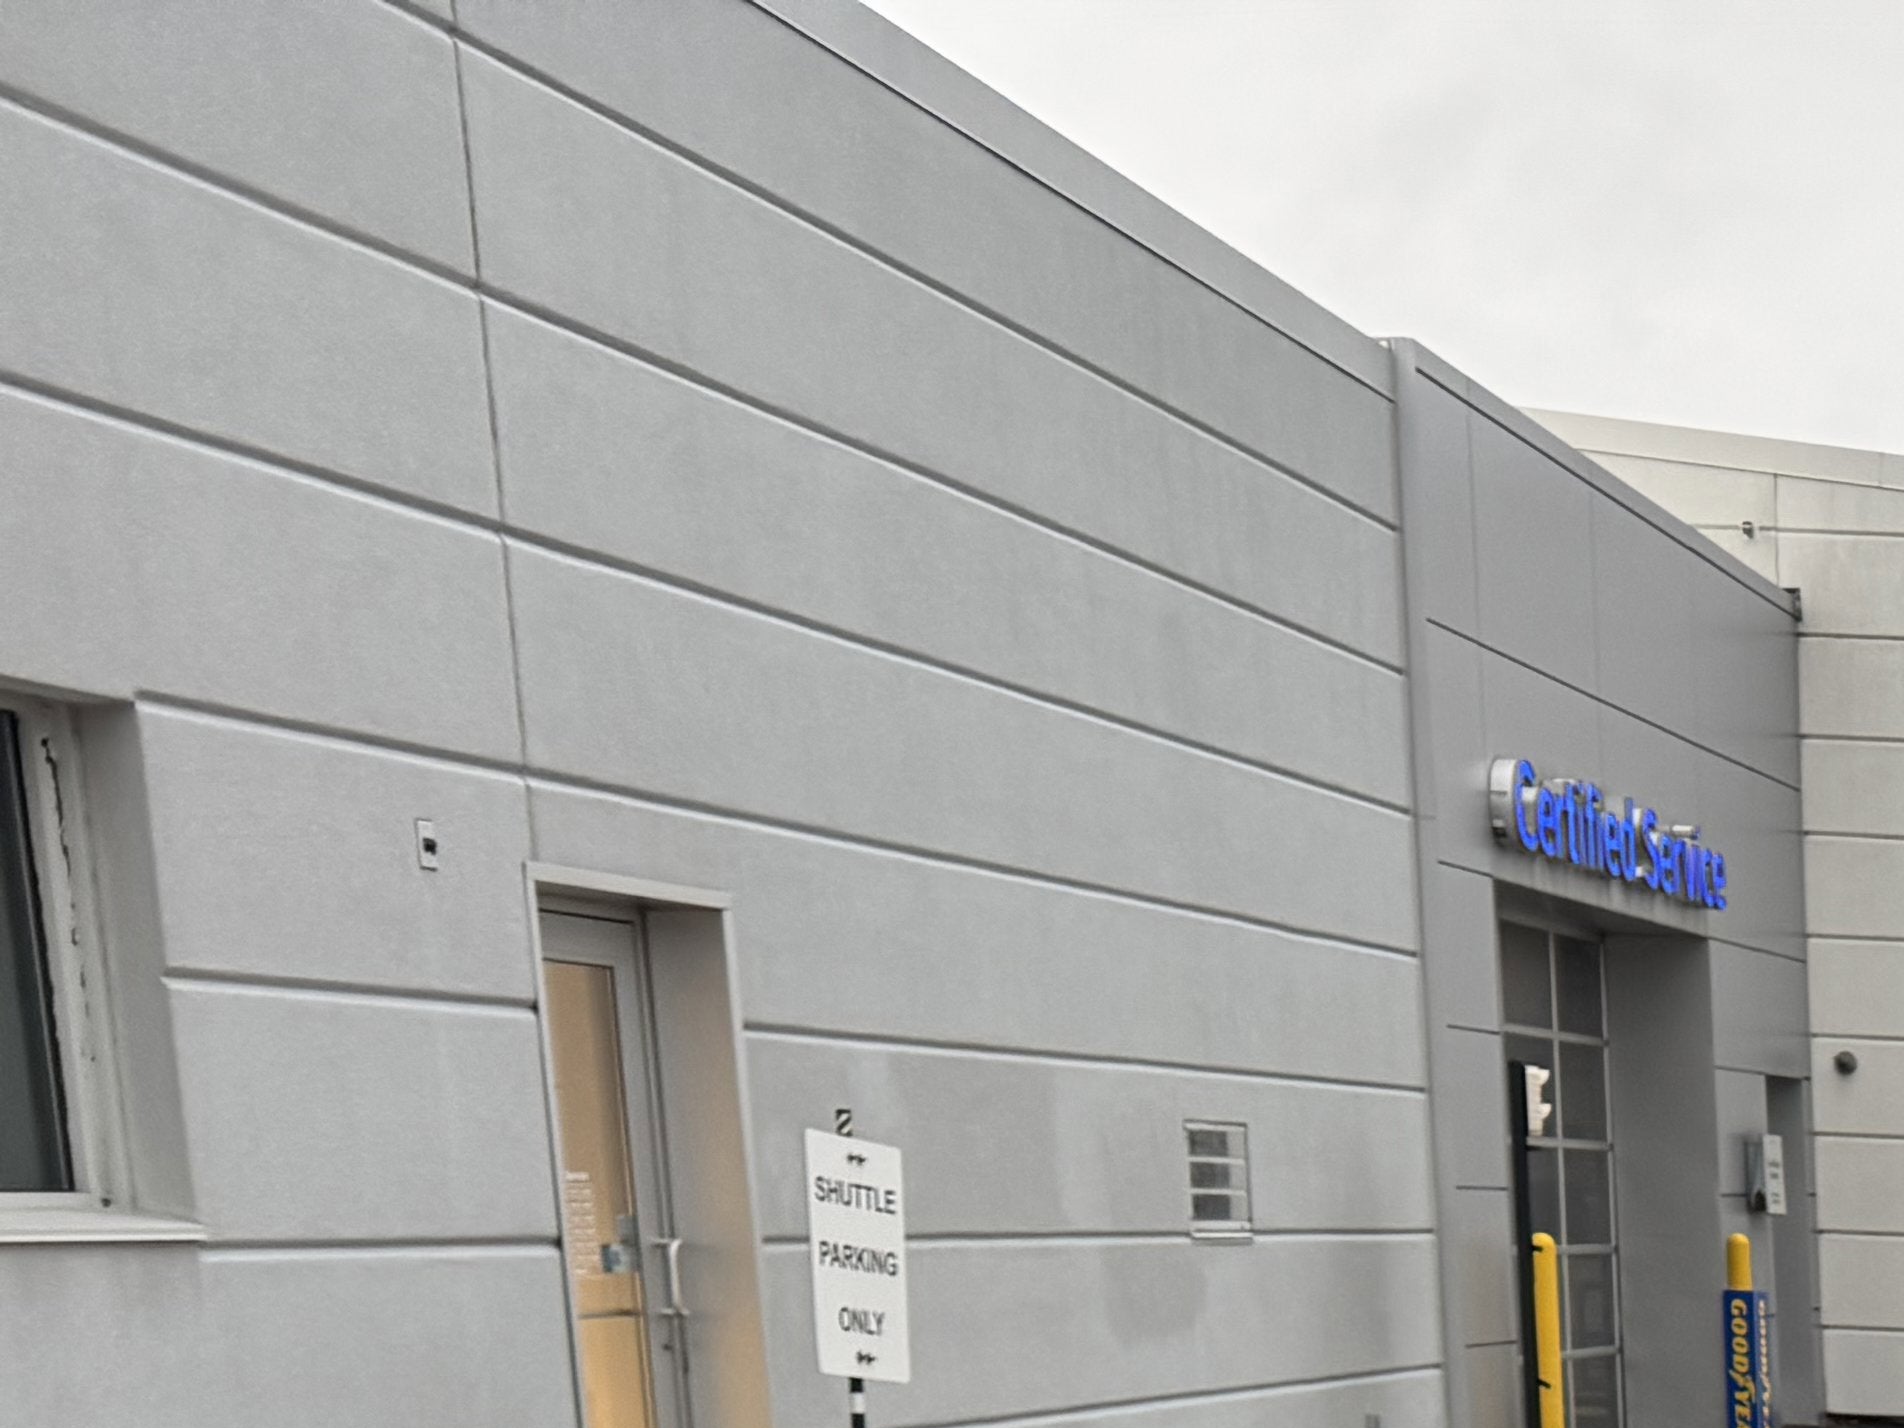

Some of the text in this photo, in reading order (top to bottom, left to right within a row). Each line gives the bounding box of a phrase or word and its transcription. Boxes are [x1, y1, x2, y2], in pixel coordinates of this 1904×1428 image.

[1513, 759, 1728, 911] Certified Service
[814, 1176, 897, 1215] SHUTTLE
[819, 1240, 898, 1277] PARKING
[838, 1307, 885, 1336] ONLY
